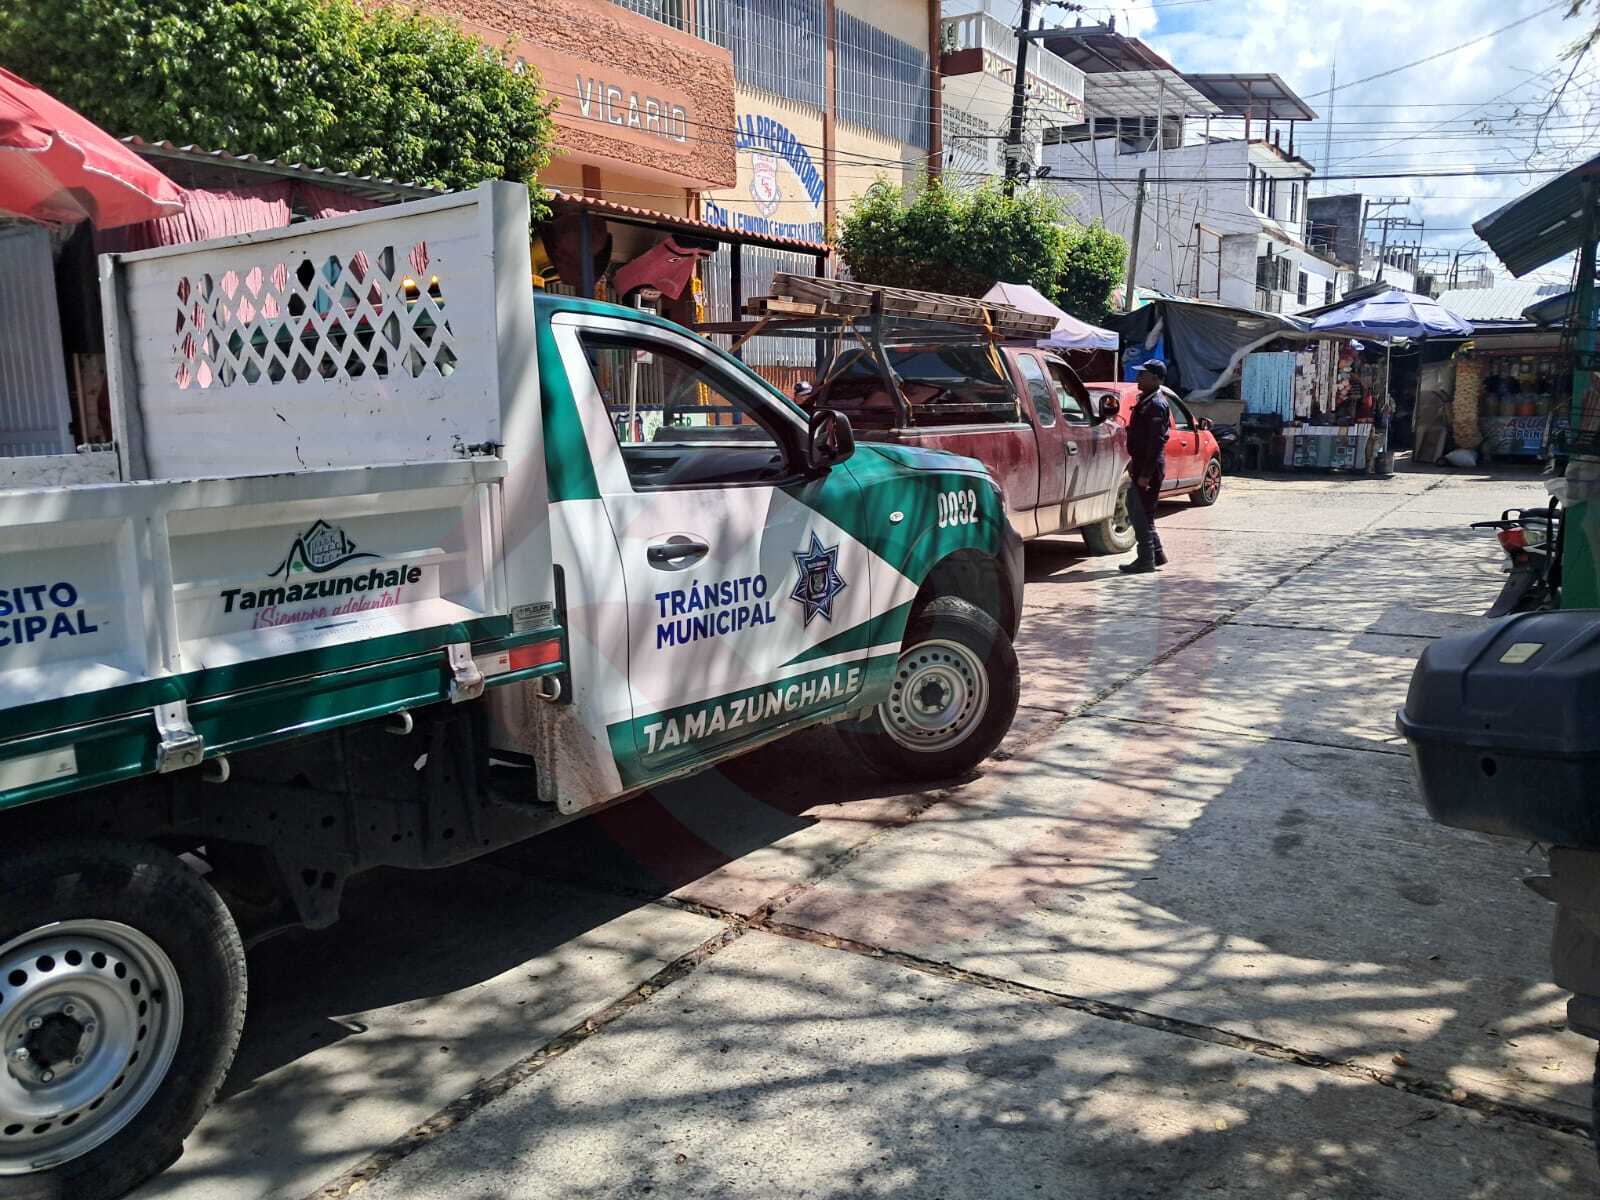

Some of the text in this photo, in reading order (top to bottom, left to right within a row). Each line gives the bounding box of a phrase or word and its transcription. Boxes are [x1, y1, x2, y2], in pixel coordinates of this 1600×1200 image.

[576, 74, 688, 143] VICARIO
[756, 114, 825, 208] PREPARATORIA
[937, 488, 978, 529] 0032
[221, 564, 422, 613] Tamazunchale
[331, 587, 401, 617] adelante!
[655, 574, 767, 618] TRÁNSITO
[656, 601, 776, 649] MUNICIPAL
[643, 666, 860, 754] TAMAZUNCHALE
